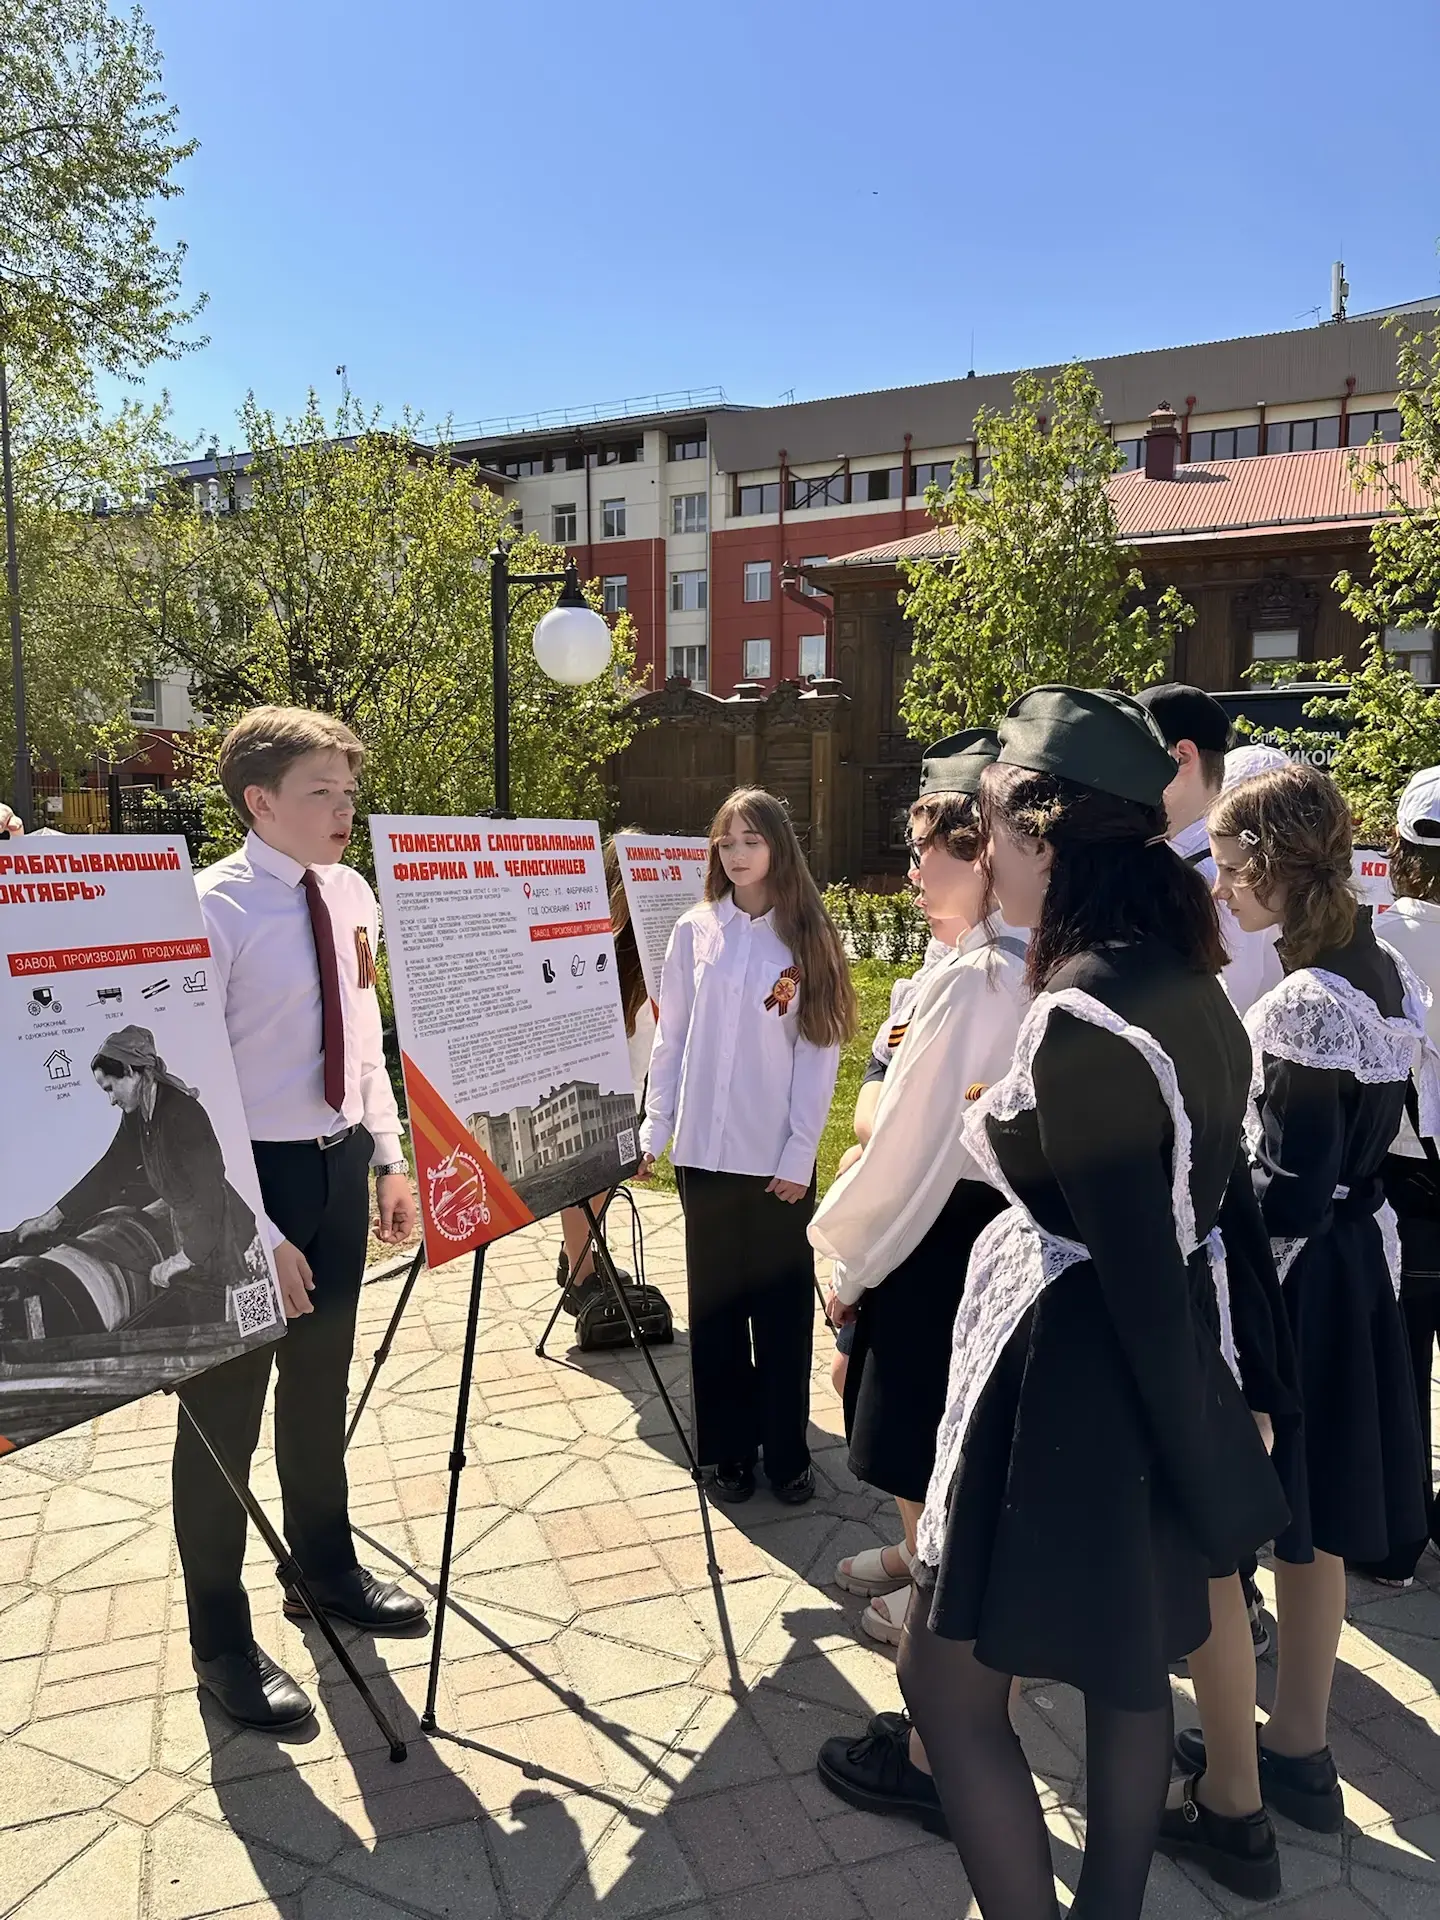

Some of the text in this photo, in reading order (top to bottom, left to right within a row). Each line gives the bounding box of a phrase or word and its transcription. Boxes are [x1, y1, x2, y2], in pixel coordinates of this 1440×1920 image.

[388, 833, 595, 853] ТЮМЕНСКАЯ САПОГОВАЛЯЛЬНАЯ
[0, 847, 181, 875] РАБАТЫВАЮЩИЙ
[393, 859, 587, 881] ФАБРИКА ИМ. ЧЕЛЮСКИНЦЕВ
[630, 868, 660, 881] ЗАВОД
[567, 886, 593, 895] ФАБРИЧНАЯ
[528, 906, 539, 916] ГОД
[575, 901, 592, 912] 1917
[532, 929, 551, 938] ЗАВОД
[15, 957, 57, 971] ЗАВОД
[63, 948, 138, 966] ПРОИЗВОДИЛ
[44, 1080, 81, 1093] СТАНДАРТНЫЕ
